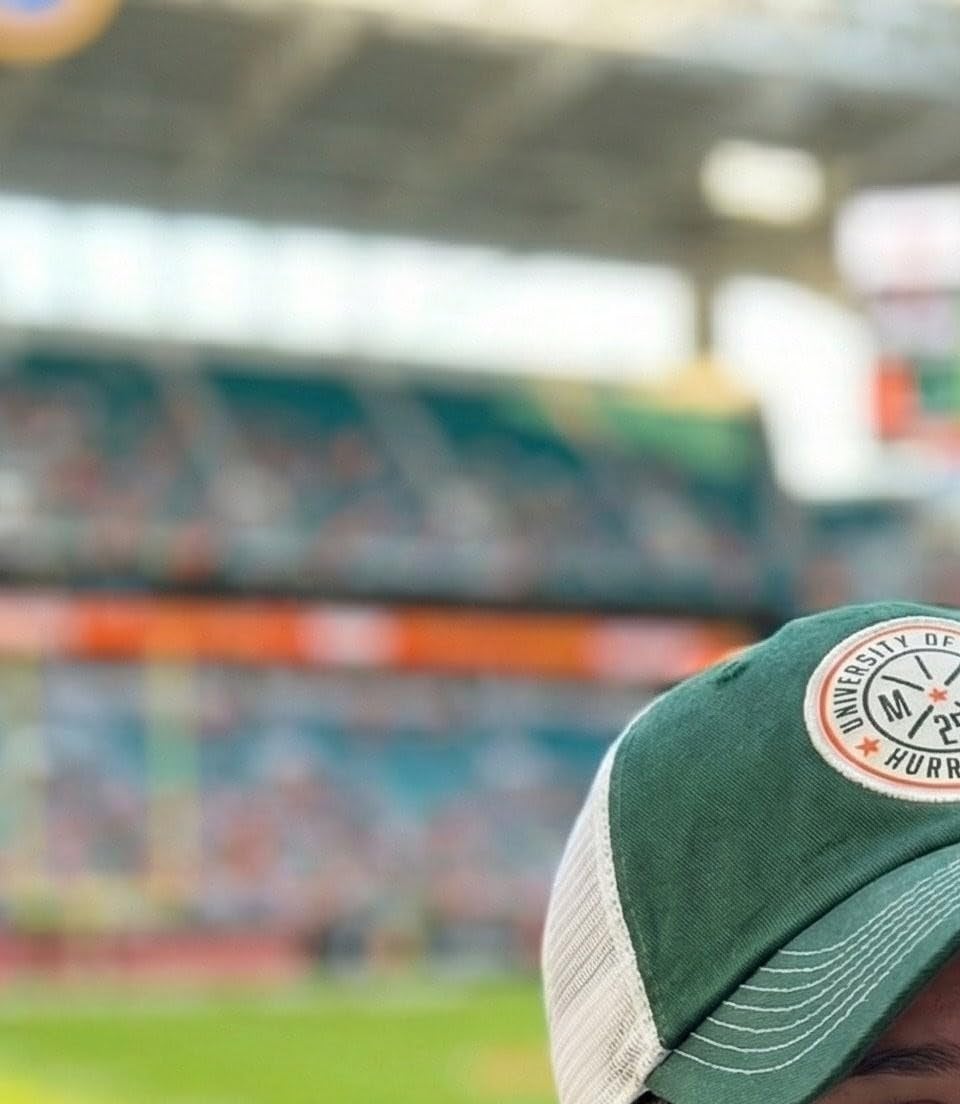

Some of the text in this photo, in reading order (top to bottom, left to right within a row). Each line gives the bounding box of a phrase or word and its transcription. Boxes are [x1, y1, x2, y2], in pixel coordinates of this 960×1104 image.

[833, 634, 907, 734] UNIVERSITY
[925, 632, 954, 647] OF
[877, 689, 912, 722] M
